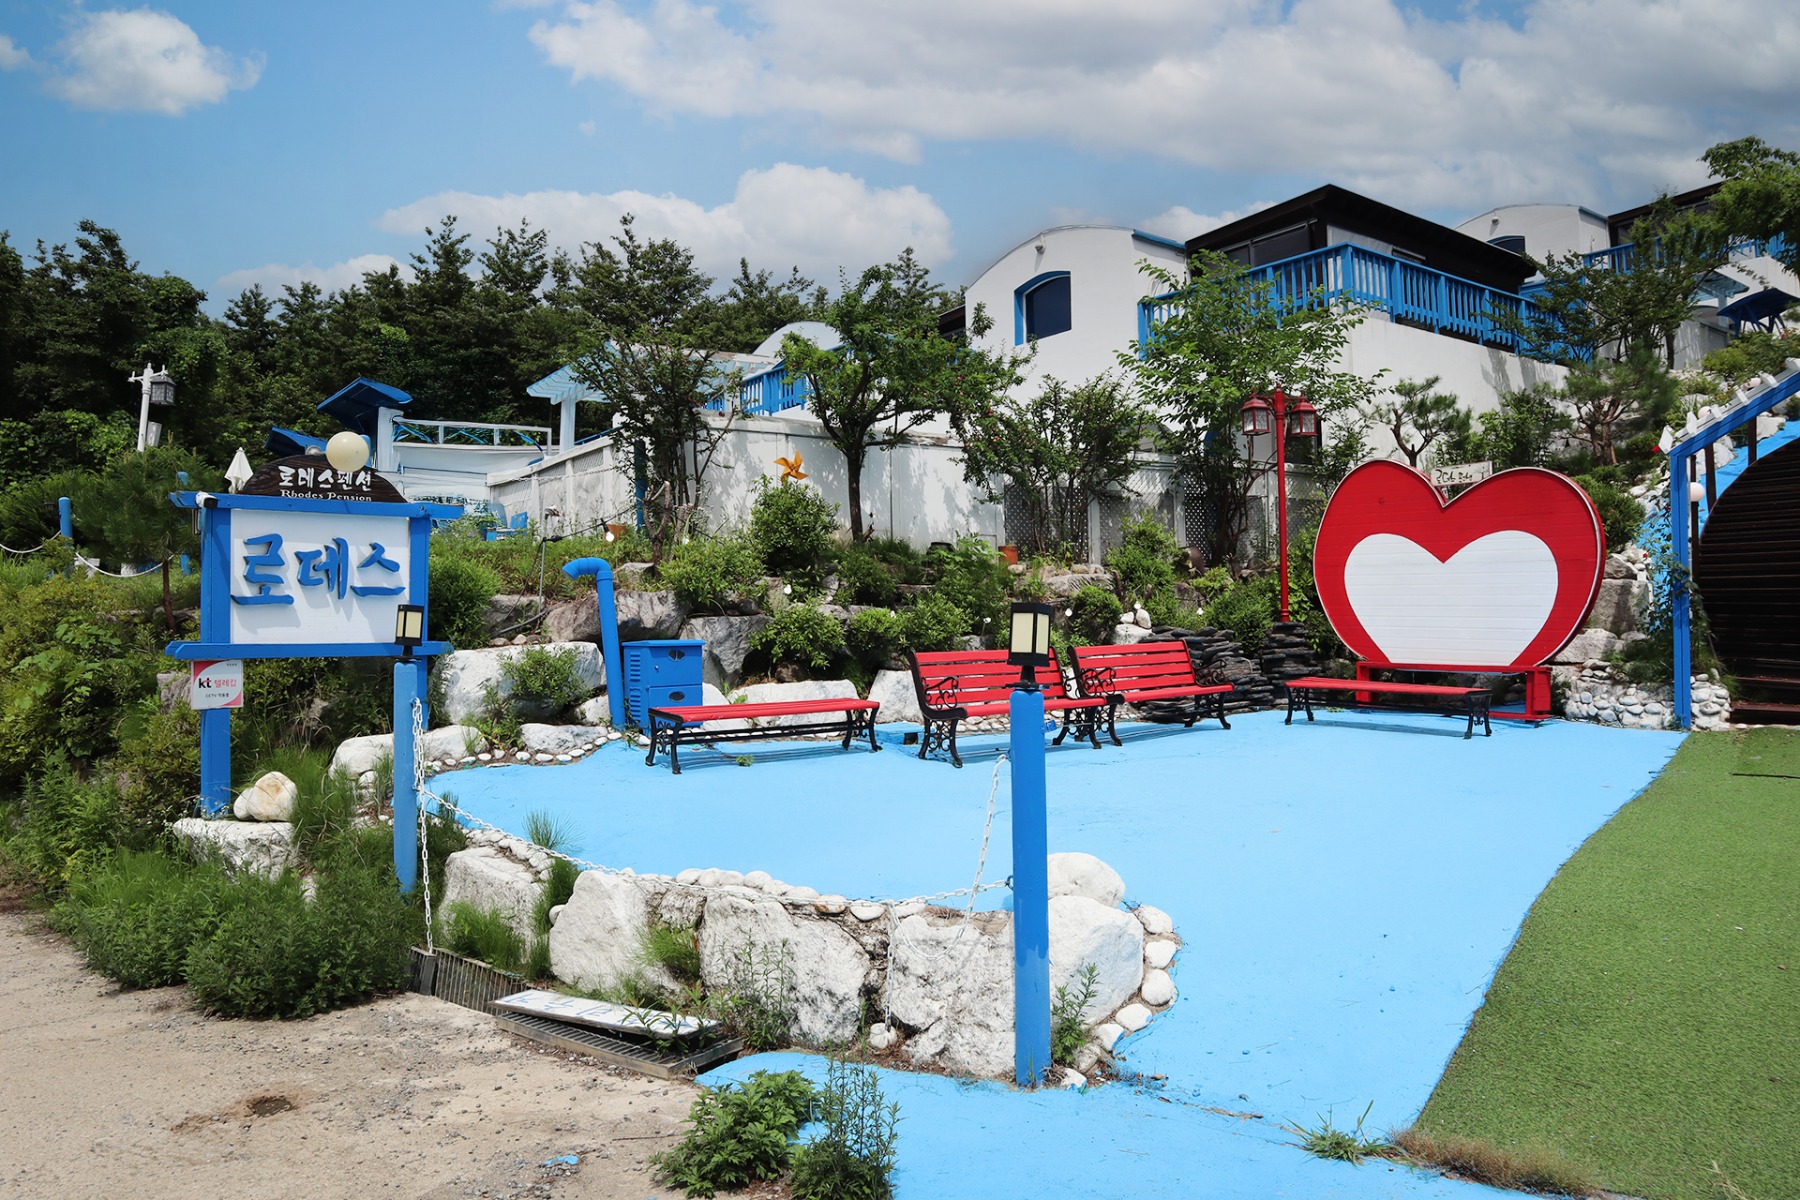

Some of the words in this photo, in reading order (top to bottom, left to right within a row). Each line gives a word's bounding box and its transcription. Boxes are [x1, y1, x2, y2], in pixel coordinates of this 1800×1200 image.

[277, 465, 372, 491] 로데스펜션
[280, 489, 324, 500] Rhodes
[326, 491, 372, 502] Pension
[230, 533, 406, 606] 로데스
[198, 677, 212, 689] kt
